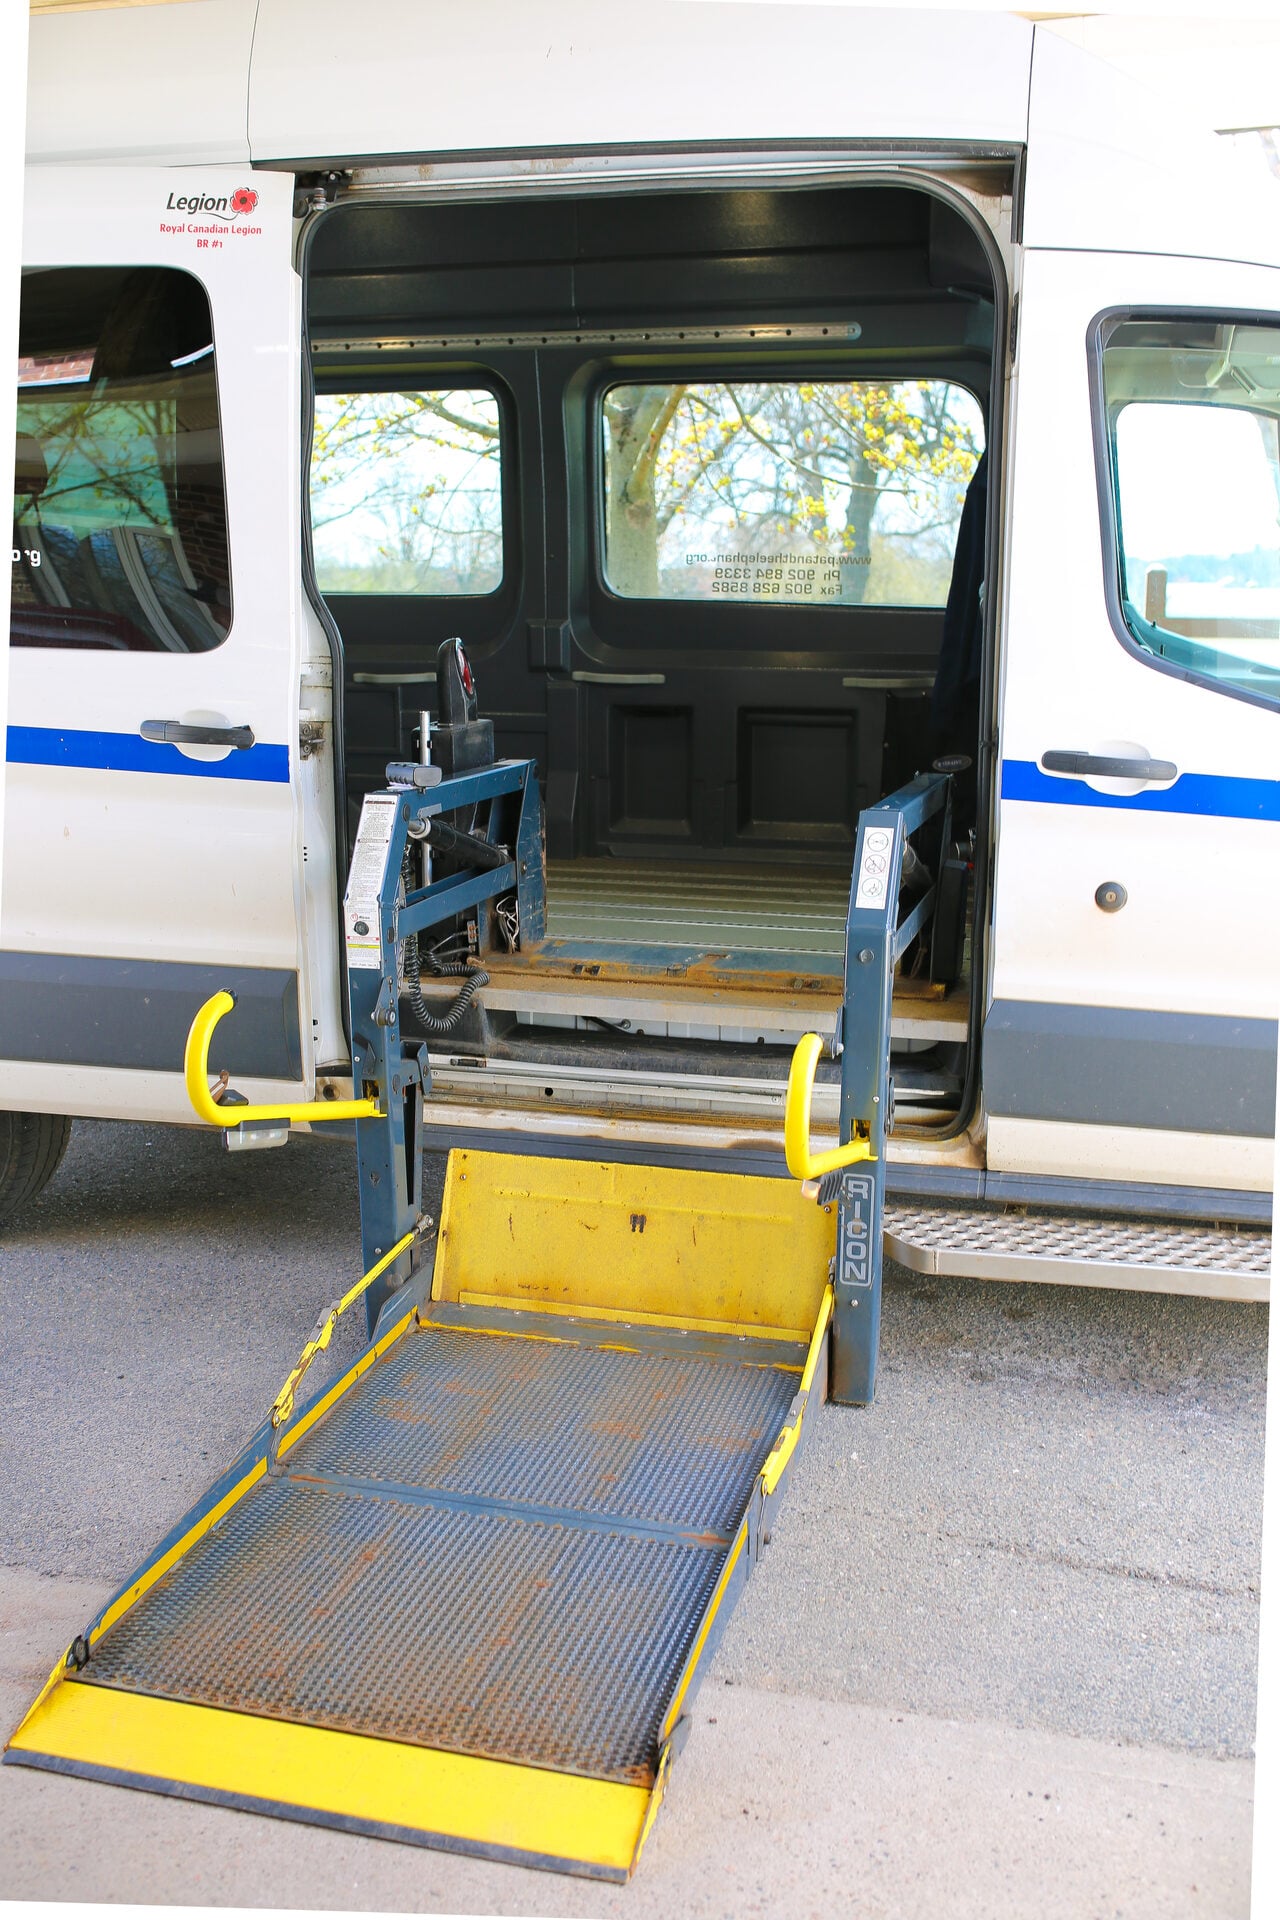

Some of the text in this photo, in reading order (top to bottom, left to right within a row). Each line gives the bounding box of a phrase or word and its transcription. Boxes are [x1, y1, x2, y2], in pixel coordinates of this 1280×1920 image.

[166, 192, 228, 215] Legion
[159, 223, 262, 236] Royal Canadian Legion
[196, 239, 223, 249] BR #1
[844, 1180, 868, 1280] RICON
